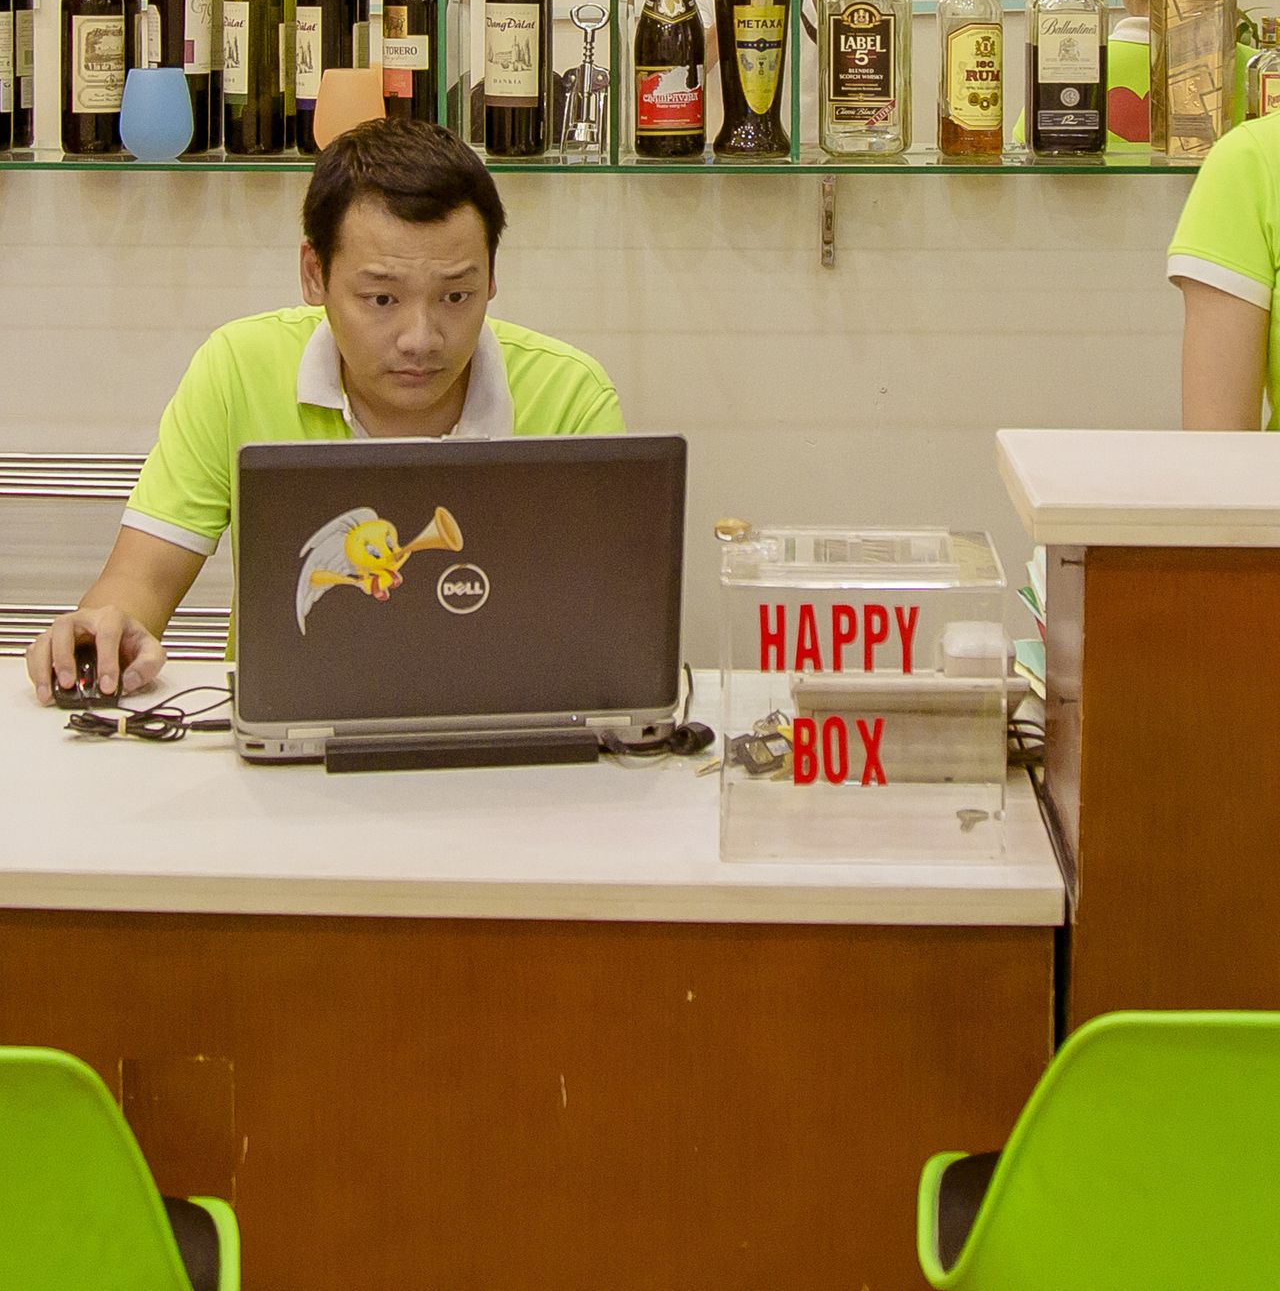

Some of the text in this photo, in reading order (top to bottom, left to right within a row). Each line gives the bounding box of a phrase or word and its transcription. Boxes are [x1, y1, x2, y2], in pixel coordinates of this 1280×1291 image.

[737, 19, 783, 29] METAXA
[386, 46, 417, 56] TORERO
[840, 35, 887, 52] LABEL
[855, 50, 869, 65] 5
[443, 578, 484, 598] DELL
[758, 603, 920, 674] HAPPY
[791, 716, 888, 787] BOX
